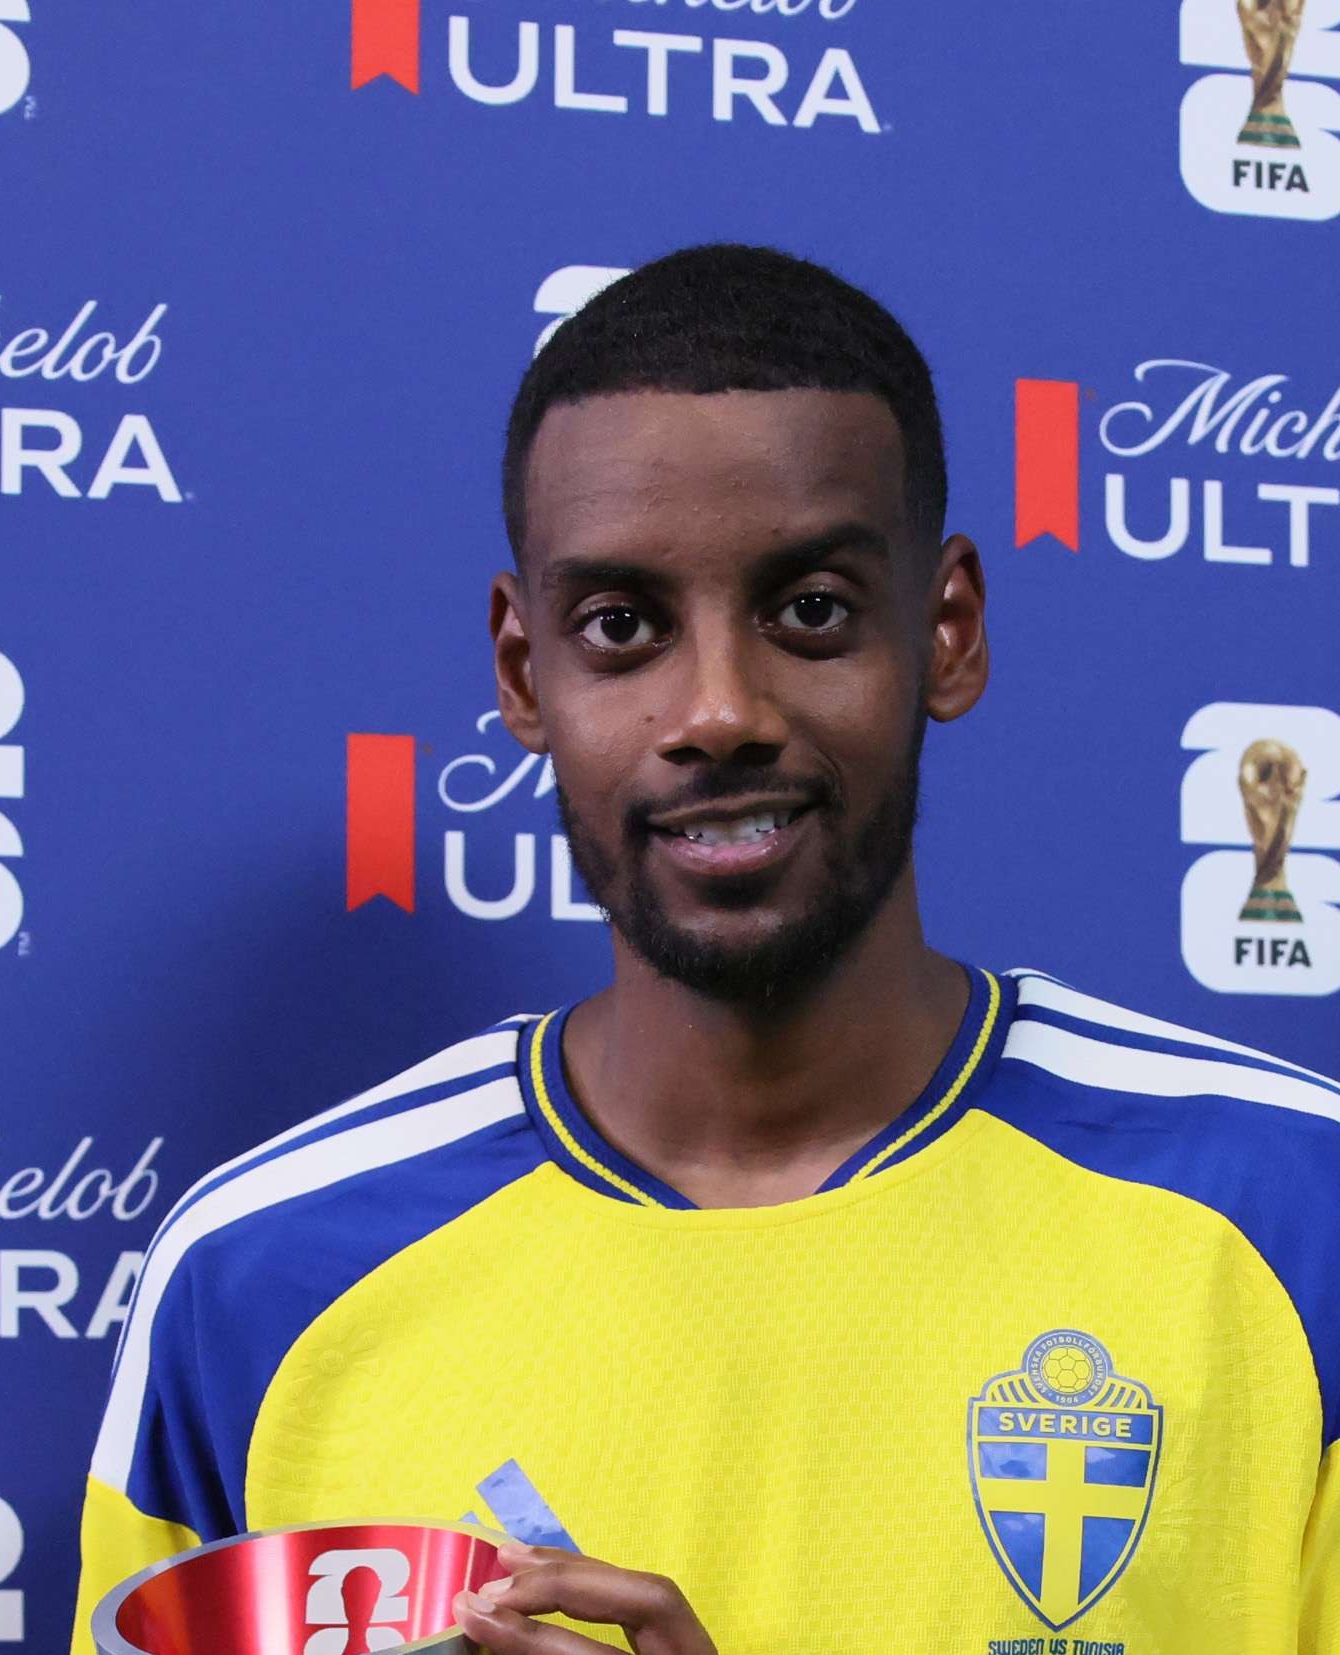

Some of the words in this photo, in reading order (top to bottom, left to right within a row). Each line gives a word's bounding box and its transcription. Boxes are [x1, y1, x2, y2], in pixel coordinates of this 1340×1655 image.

[449, 16, 881, 133] ULTRA
[1233, 160, 1309, 192] FIFA
[1235, 938, 1311, 967] FIFA
[998, 1411, 1133, 1439] SVERIGE
